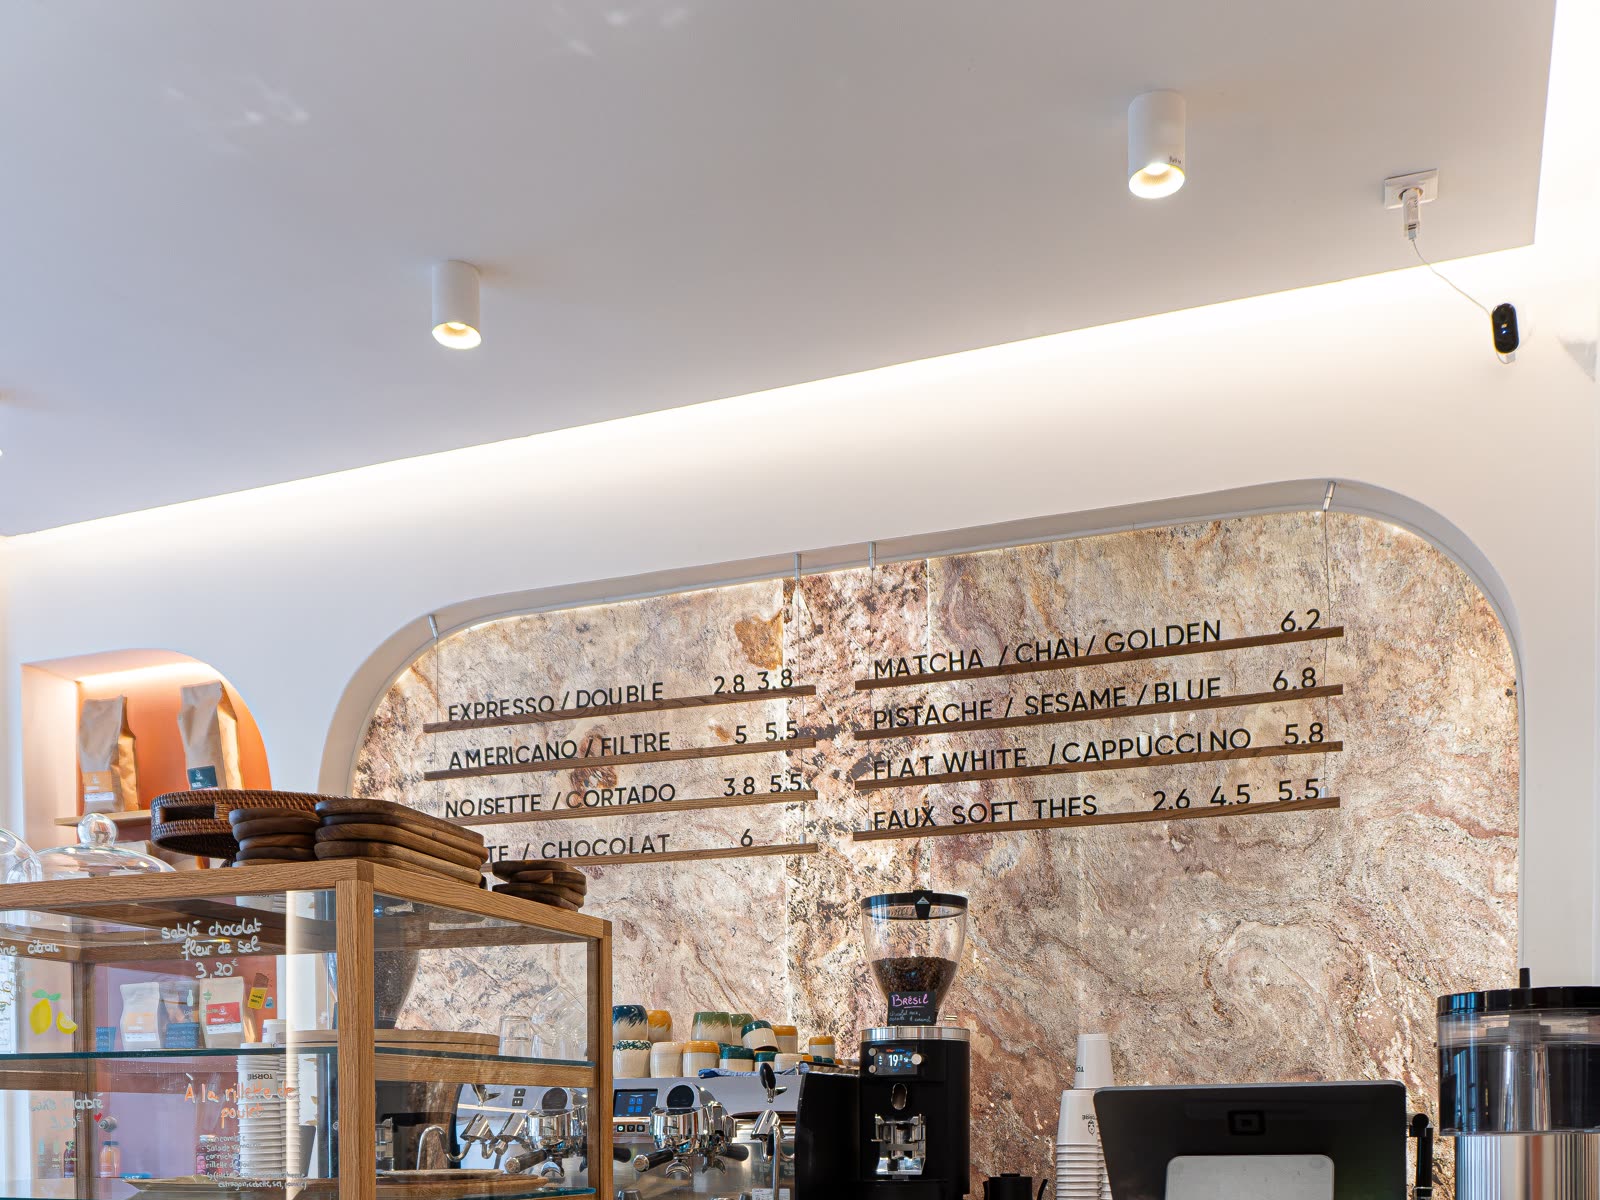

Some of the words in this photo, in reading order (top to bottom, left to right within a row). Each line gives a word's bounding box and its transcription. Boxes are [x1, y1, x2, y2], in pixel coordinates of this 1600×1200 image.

[874, 649, 984, 680] MATCHA
[1015, 636, 1080, 663] CHAI
[1104, 619, 1221, 653] GOLDEN
[1280, 608, 1321, 633] 6.2
[448, 695, 555, 721] EXPRESSO
[576, 682, 664, 709] DOUBLE
[713, 674, 746, 695] 2.8
[757, 669, 793, 690] 3.8
[874, 700, 993, 729] PISTACHE
[1024, 686, 1127, 716] SESAME
[1154, 676, 1221, 704] BLUE
[1272, 667, 1317, 692] 6.8
[449, 740, 578, 770] AMERICANO
[600, 731, 671, 757] FILTRE
[734, 725, 748, 744] 5
[765, 720, 799, 742] 5.5
[873, 755, 934, 780] FLAT
[942, 747, 1027, 773] WHITE
[1062, 727, 1252, 764] CAPPUCCINO
[1284, 722, 1325, 745] 5.8
[445, 793, 542, 818] NOISETTE
[566, 783, 676, 809] CORTADO
[723, 776, 755, 796] 3.8
[770, 773, 802, 793] 5.5
[874, 805, 937, 831] EAUX
[952, 801, 1018, 825] SOFT
[1032, 794, 1098, 820] THES
[1152, 789, 1191, 811] 2.6
[1210, 784, 1251, 805] 4.5
[1278, 778, 1320, 802] 5.5
[541, 834, 671, 859] CHOCOLAT
[740, 828, 753, 847] 6
[181, 938, 213, 961] fleur
[217, 940, 232, 954] de
[237, 935, 261, 954] sel
[208, 917, 262, 937] chocolat
[201, 1083, 219, 1103] la
[220, 1102, 265, 1129] poulet
